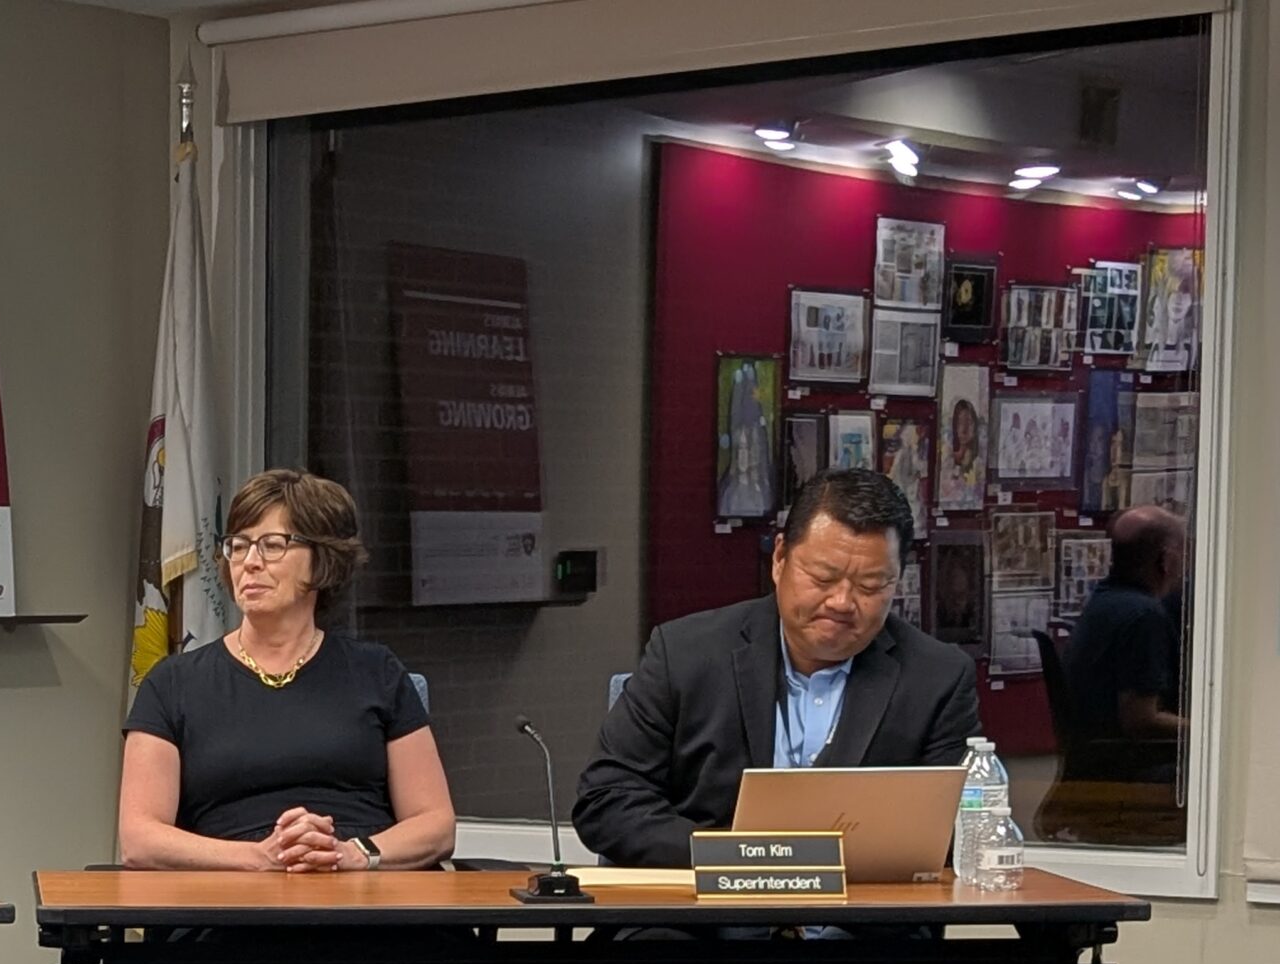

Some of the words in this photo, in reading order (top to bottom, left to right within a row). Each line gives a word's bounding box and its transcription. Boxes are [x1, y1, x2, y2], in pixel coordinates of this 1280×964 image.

[739, 844, 765, 857] Tom
[770, 844, 793, 857] Kim
[718, 876, 822, 891] Superintendent
